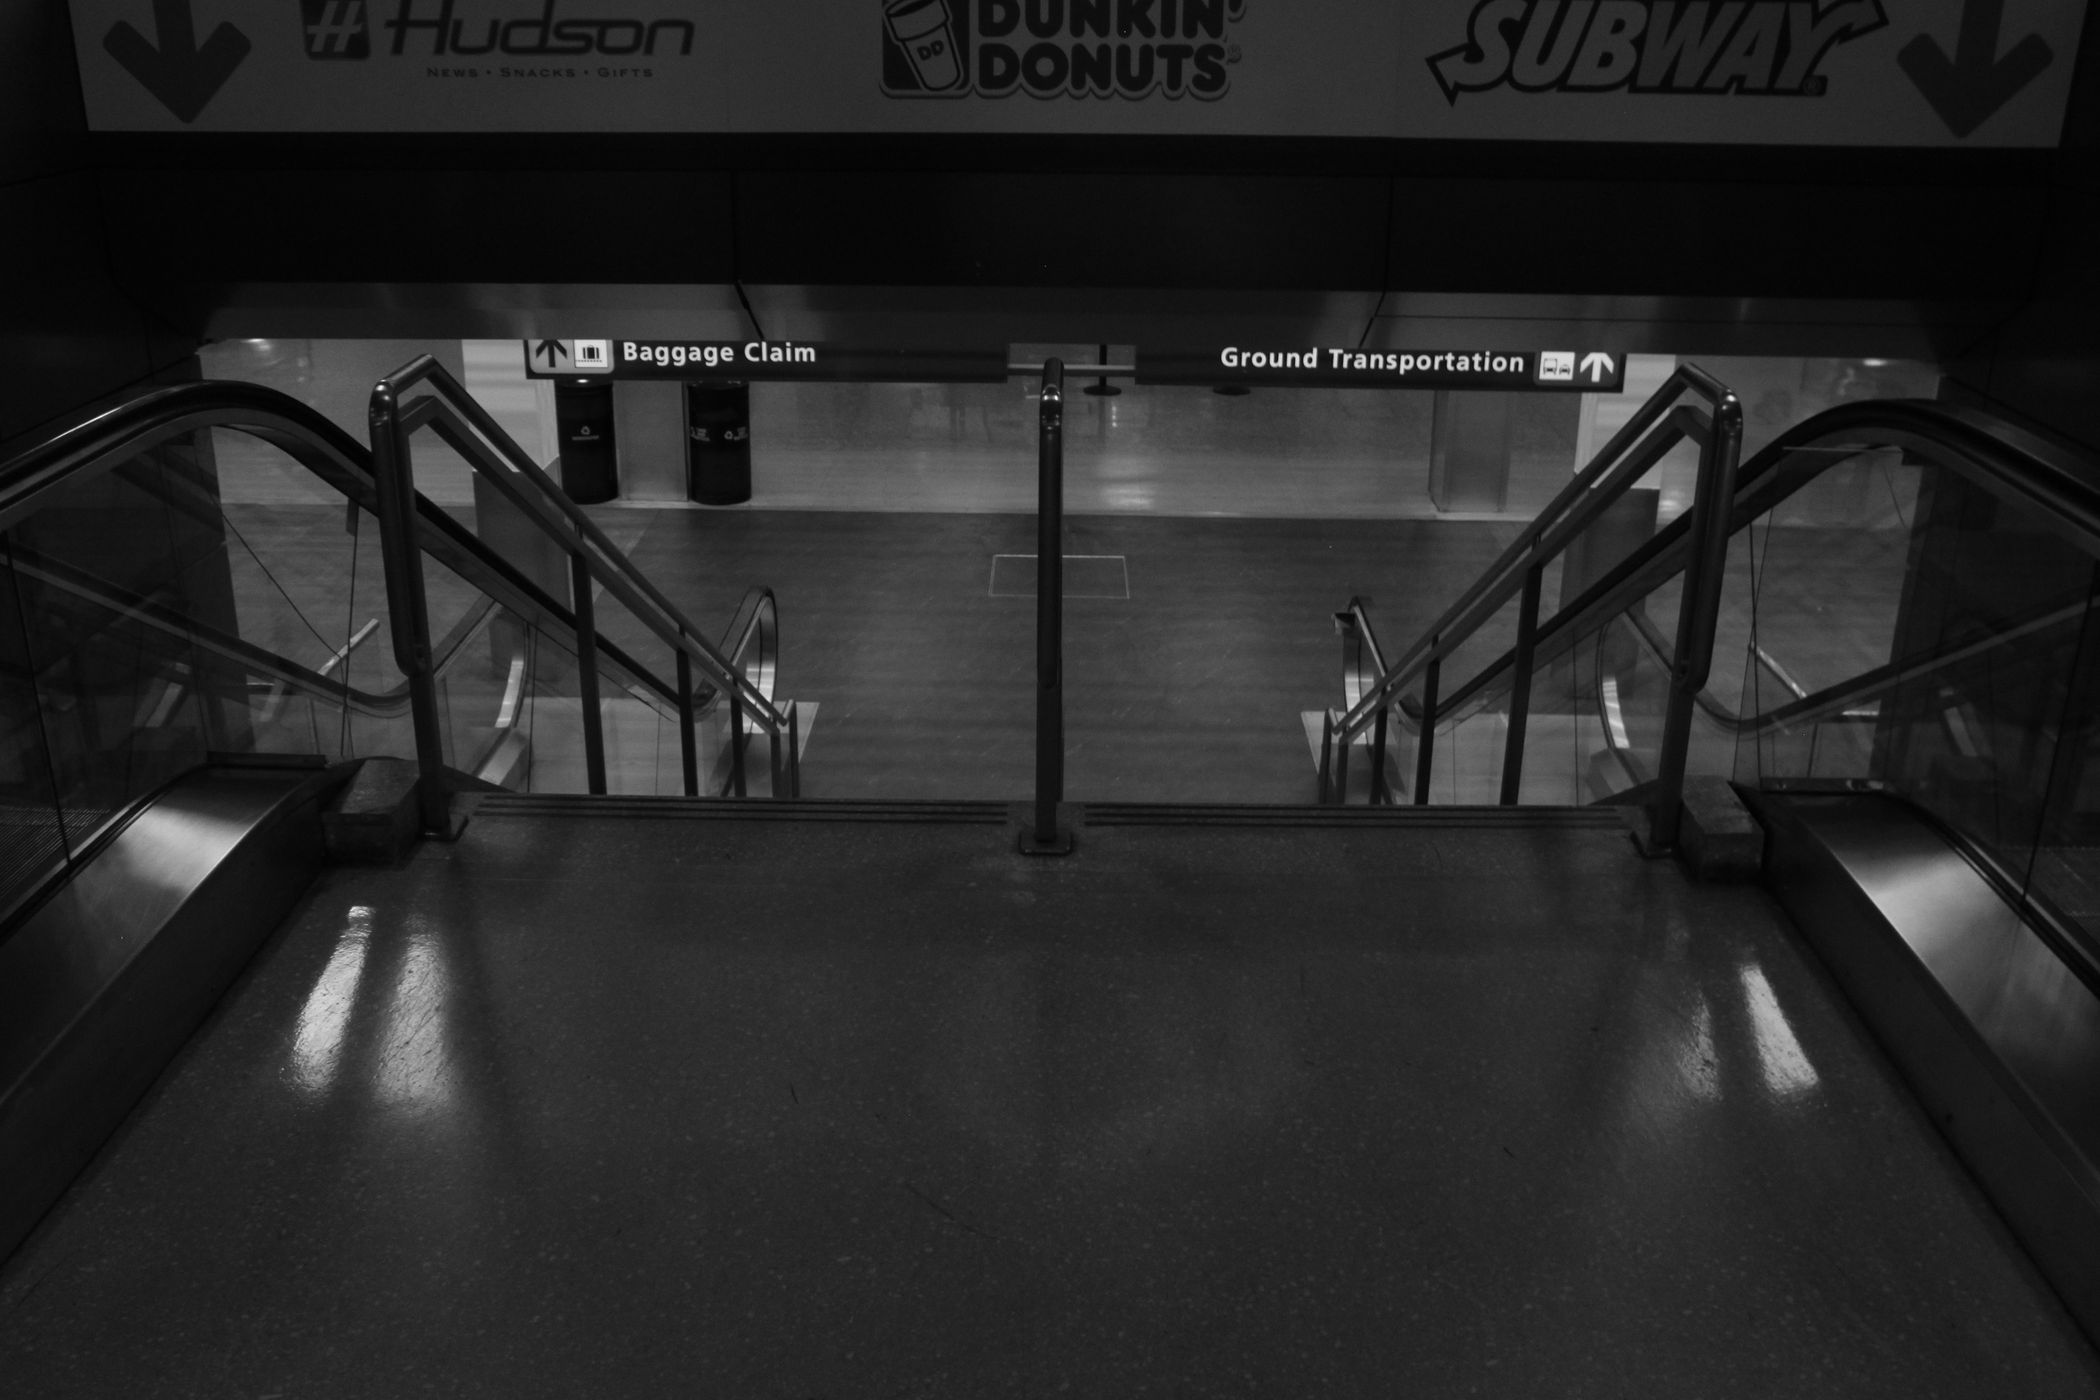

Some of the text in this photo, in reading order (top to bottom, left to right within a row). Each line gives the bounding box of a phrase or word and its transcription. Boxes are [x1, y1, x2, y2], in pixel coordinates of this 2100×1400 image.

[384, 0, 695, 55] Hudson
[916, 40, 945, 60] DD
[1428, 0, 1886, 100] SUBWAY
[426, 66, 654, 78] NEWS SNACKS GIFTS
[978, 42, 1227, 92] DONUTS
[623, 341, 816, 367] Baggage Claim
[1220, 346, 1525, 375] Ground Transportation
